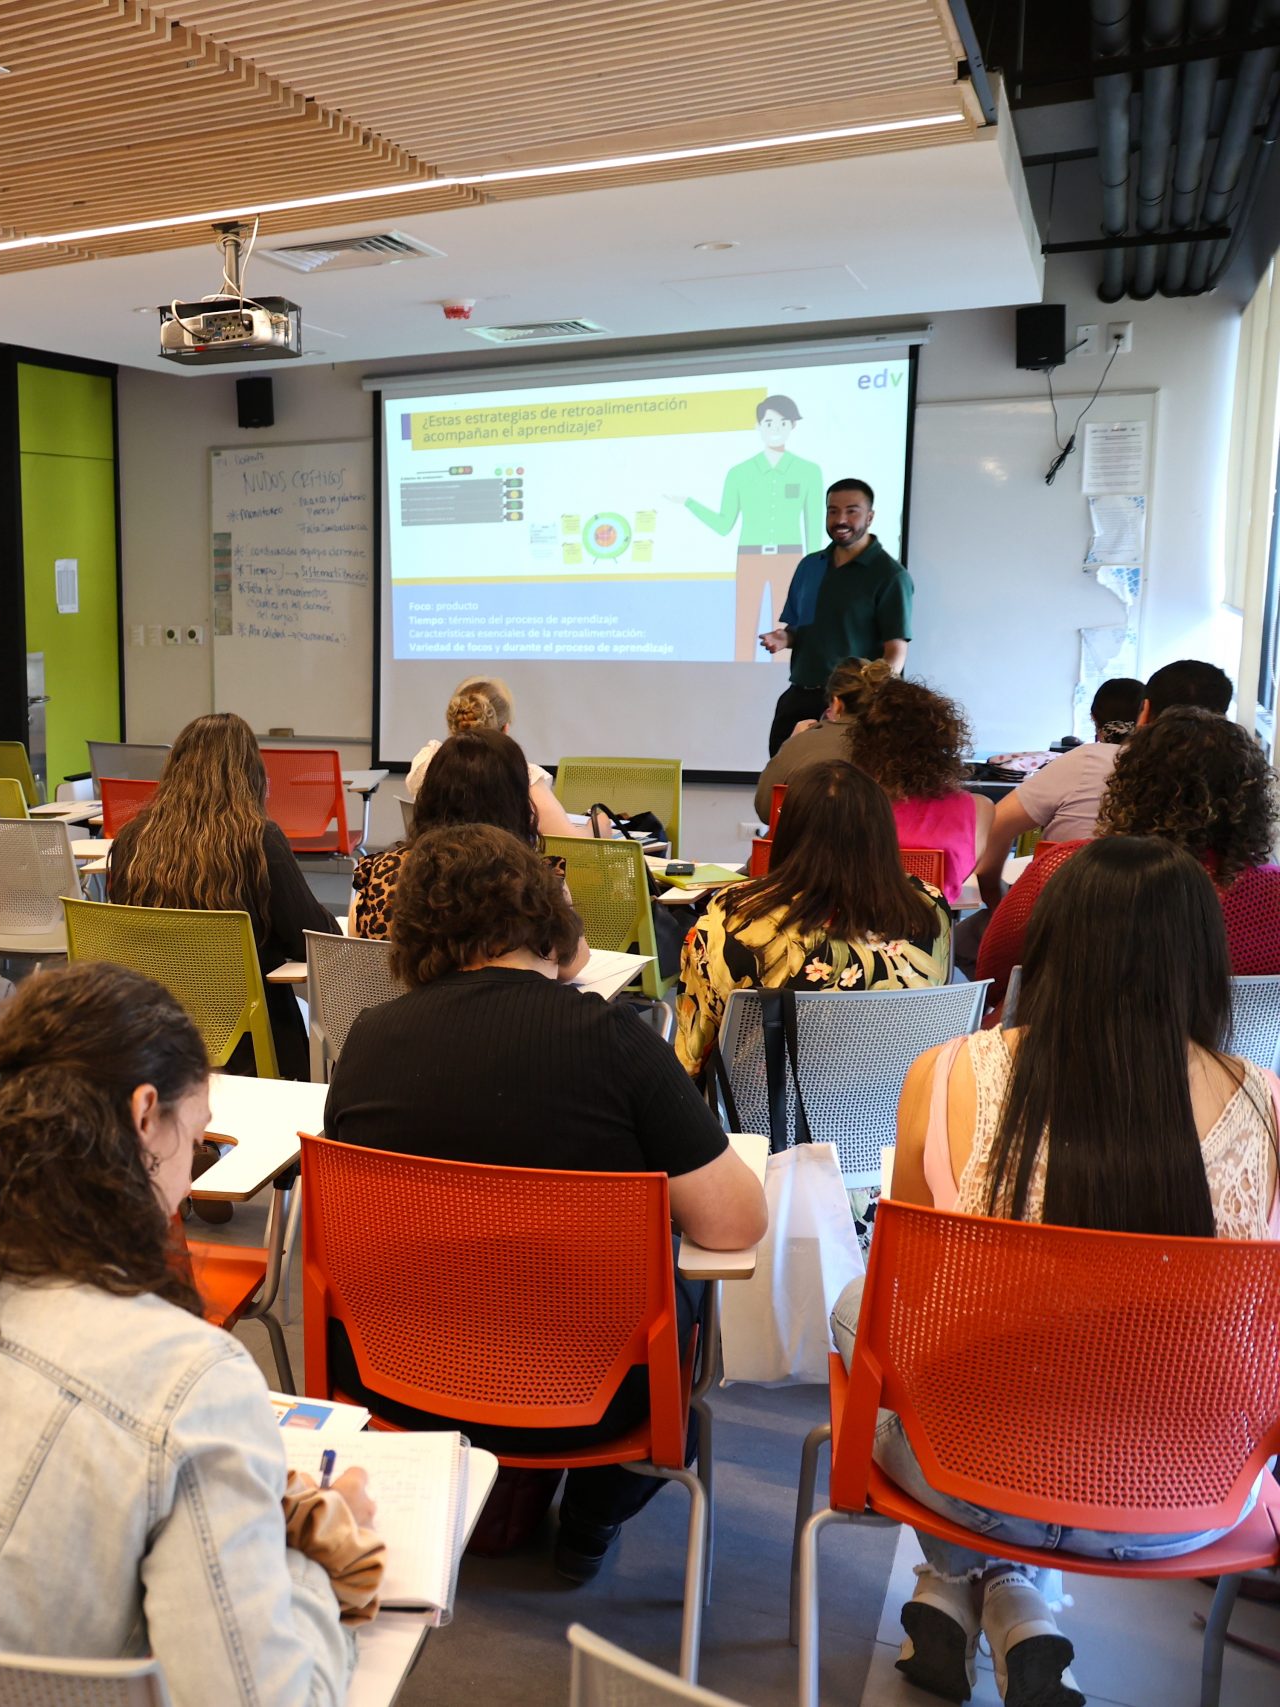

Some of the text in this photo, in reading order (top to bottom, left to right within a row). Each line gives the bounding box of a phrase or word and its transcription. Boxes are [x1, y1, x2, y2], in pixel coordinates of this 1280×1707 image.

[857, 368, 903, 390] edv
[422, 397, 688, 430] ¿Estas estrategias de retroalimentación
[423, 419, 603, 444] acompañan el aprendizaje?
[408, 601, 479, 614] Foco: producto
[408, 614, 619, 627] Tiempo: término del proceso de aprendizaje
[409, 628, 646, 639] Características esenciales de la retroalimentación:
[408, 642, 674, 655] Variedad de focos y durante el proceso de aprendizaje
